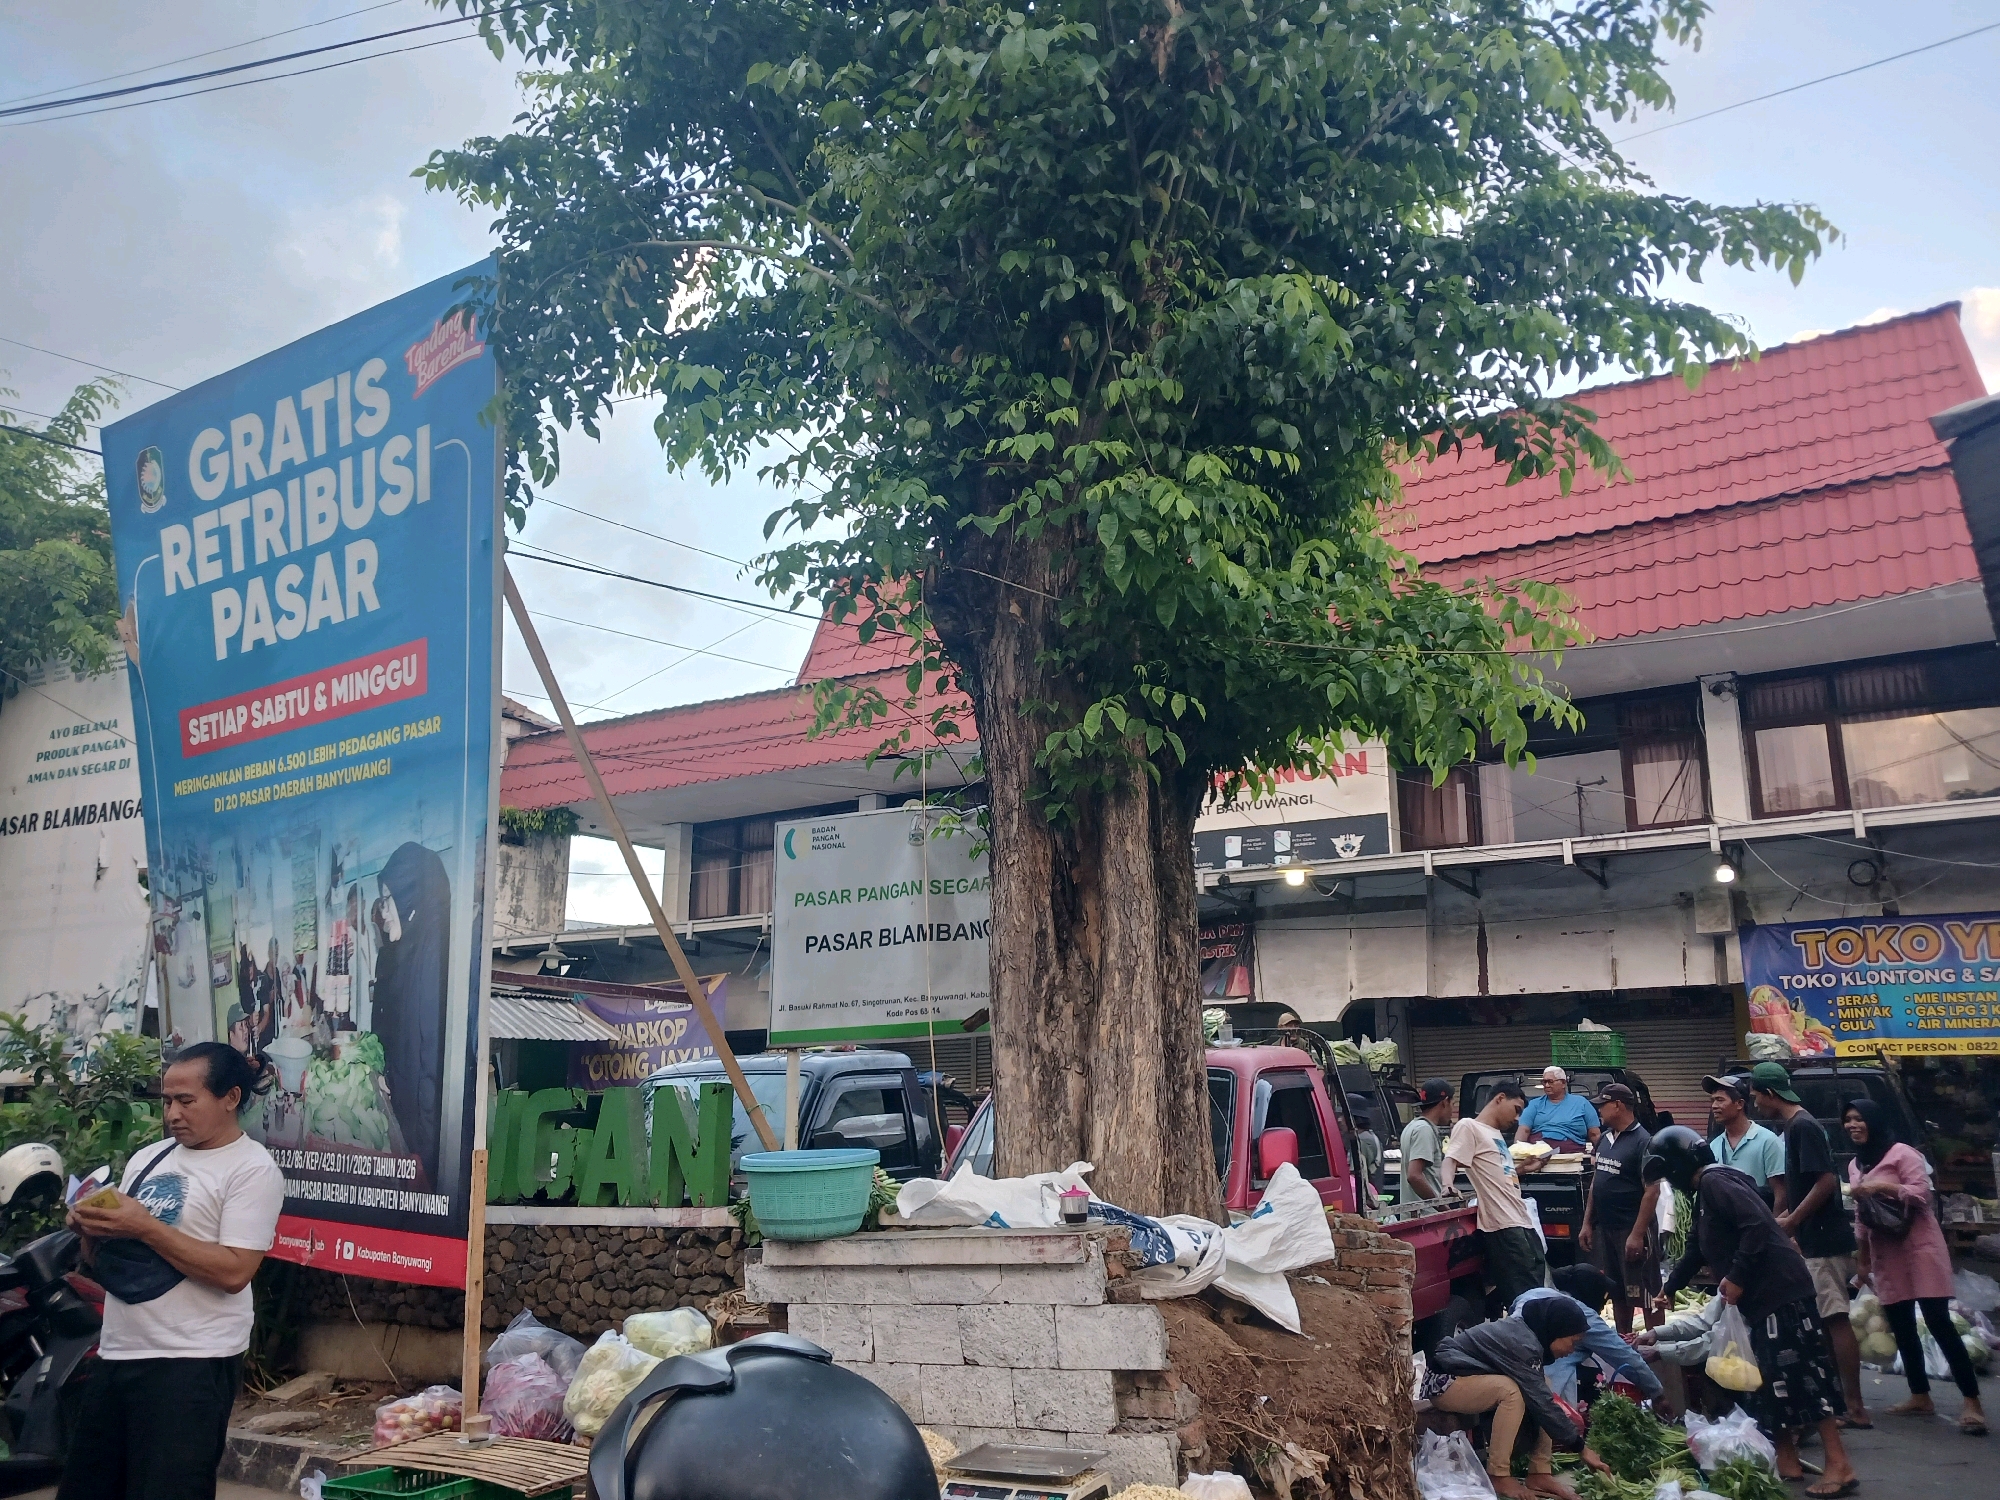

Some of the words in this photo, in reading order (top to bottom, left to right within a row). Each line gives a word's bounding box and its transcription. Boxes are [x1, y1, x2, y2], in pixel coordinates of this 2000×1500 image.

[405, 309, 464, 373] Tandang
[188, 357, 391, 501] GRATIS
[160, 423, 431, 597] RETRIBUSI
[211, 538, 381, 662] PASAR
[188, 705, 248, 745] SETIAP
[251, 687, 310, 729] SABTU
[313, 681, 328, 712] &
[331, 653, 417, 707] MINGGU
[49, 727, 70, 740] AYO
[72, 719, 118, 737] BELANJA
[36, 746, 79, 763] PRODUK
[82, 739, 127, 755] PANGAN
[174, 767, 242, 797] MERINGANKAN
[244, 759, 276, 780] BEBAN
[278, 751, 306, 773] 6.500
[308, 743, 336, 766] LEBIH
[338, 726, 401, 758] PEDAGANG
[403, 715, 441, 741] PASAR
[26, 770, 55, 785] AMAN
[57, 766, 79, 780] DAN
[81, 761, 116, 777] SEGAR
[118, 757, 131, 770] DI
[214, 797, 225, 813] DI
[226, 794, 238, 811] 20
[240, 786, 271, 808] PASAR
[272, 776, 313, 800] DAERAH
[315, 757, 391, 791] BANYUWANGI
[1216, 794, 1313, 815] BANYUWANGI
[812, 826, 836, 834] BADAN
[812, 833, 840, 842] PANGAN
[811, 842, 846, 850] NASIONAL
[795, 889, 851, 907] PASAR
[857, 880, 923, 902] PANGAN
[805, 930, 872, 953] PASAR
[1793, 922, 1943, 968] TOKO
[1779, 974, 1836, 990] TOKO
[1841, 967, 1956, 987] KLONTONG
[1961, 967, 1976, 983] &
[813, 1002, 838, 1010] Rahmat
[1836, 994, 1878, 1006] BERAS
[1914, 993, 1939, 1004] MIE
[1838, 1006, 1892, 1019] MINYAK
[1915, 1005, 1946, 1017] GAS
[1949, 1004, 1976, 1016] LPG
[1980, 1004, 1988, 1016] 3
[608, 1017, 688, 1050] WARKOP
[1839, 1019, 1876, 1032] GULA
[1917, 1018, 1942, 1030] AIR
[1847, 1042, 1903, 1054] CONTACT
[1907, 1042, 1957, 1052] PERSON
[1966, 1041, 1998, 1051] 0822
[373, 1157, 396, 1178] TAHUN
[397, 1158, 416, 1179] 2026
[137, 1186, 178, 1216] Jogja
[301, 1180, 321, 1200] PASAR
[322, 1182, 349, 1203] DAERAH
[350, 1185, 357, 1205] DI
[357, 1186, 398, 1210] KABUPATEN
[399, 1191, 450, 1216] BANYUWANGI
[357, 1245, 392, 1264] Kabupaten
[392, 1250, 433, 1273] Banyuwangi
